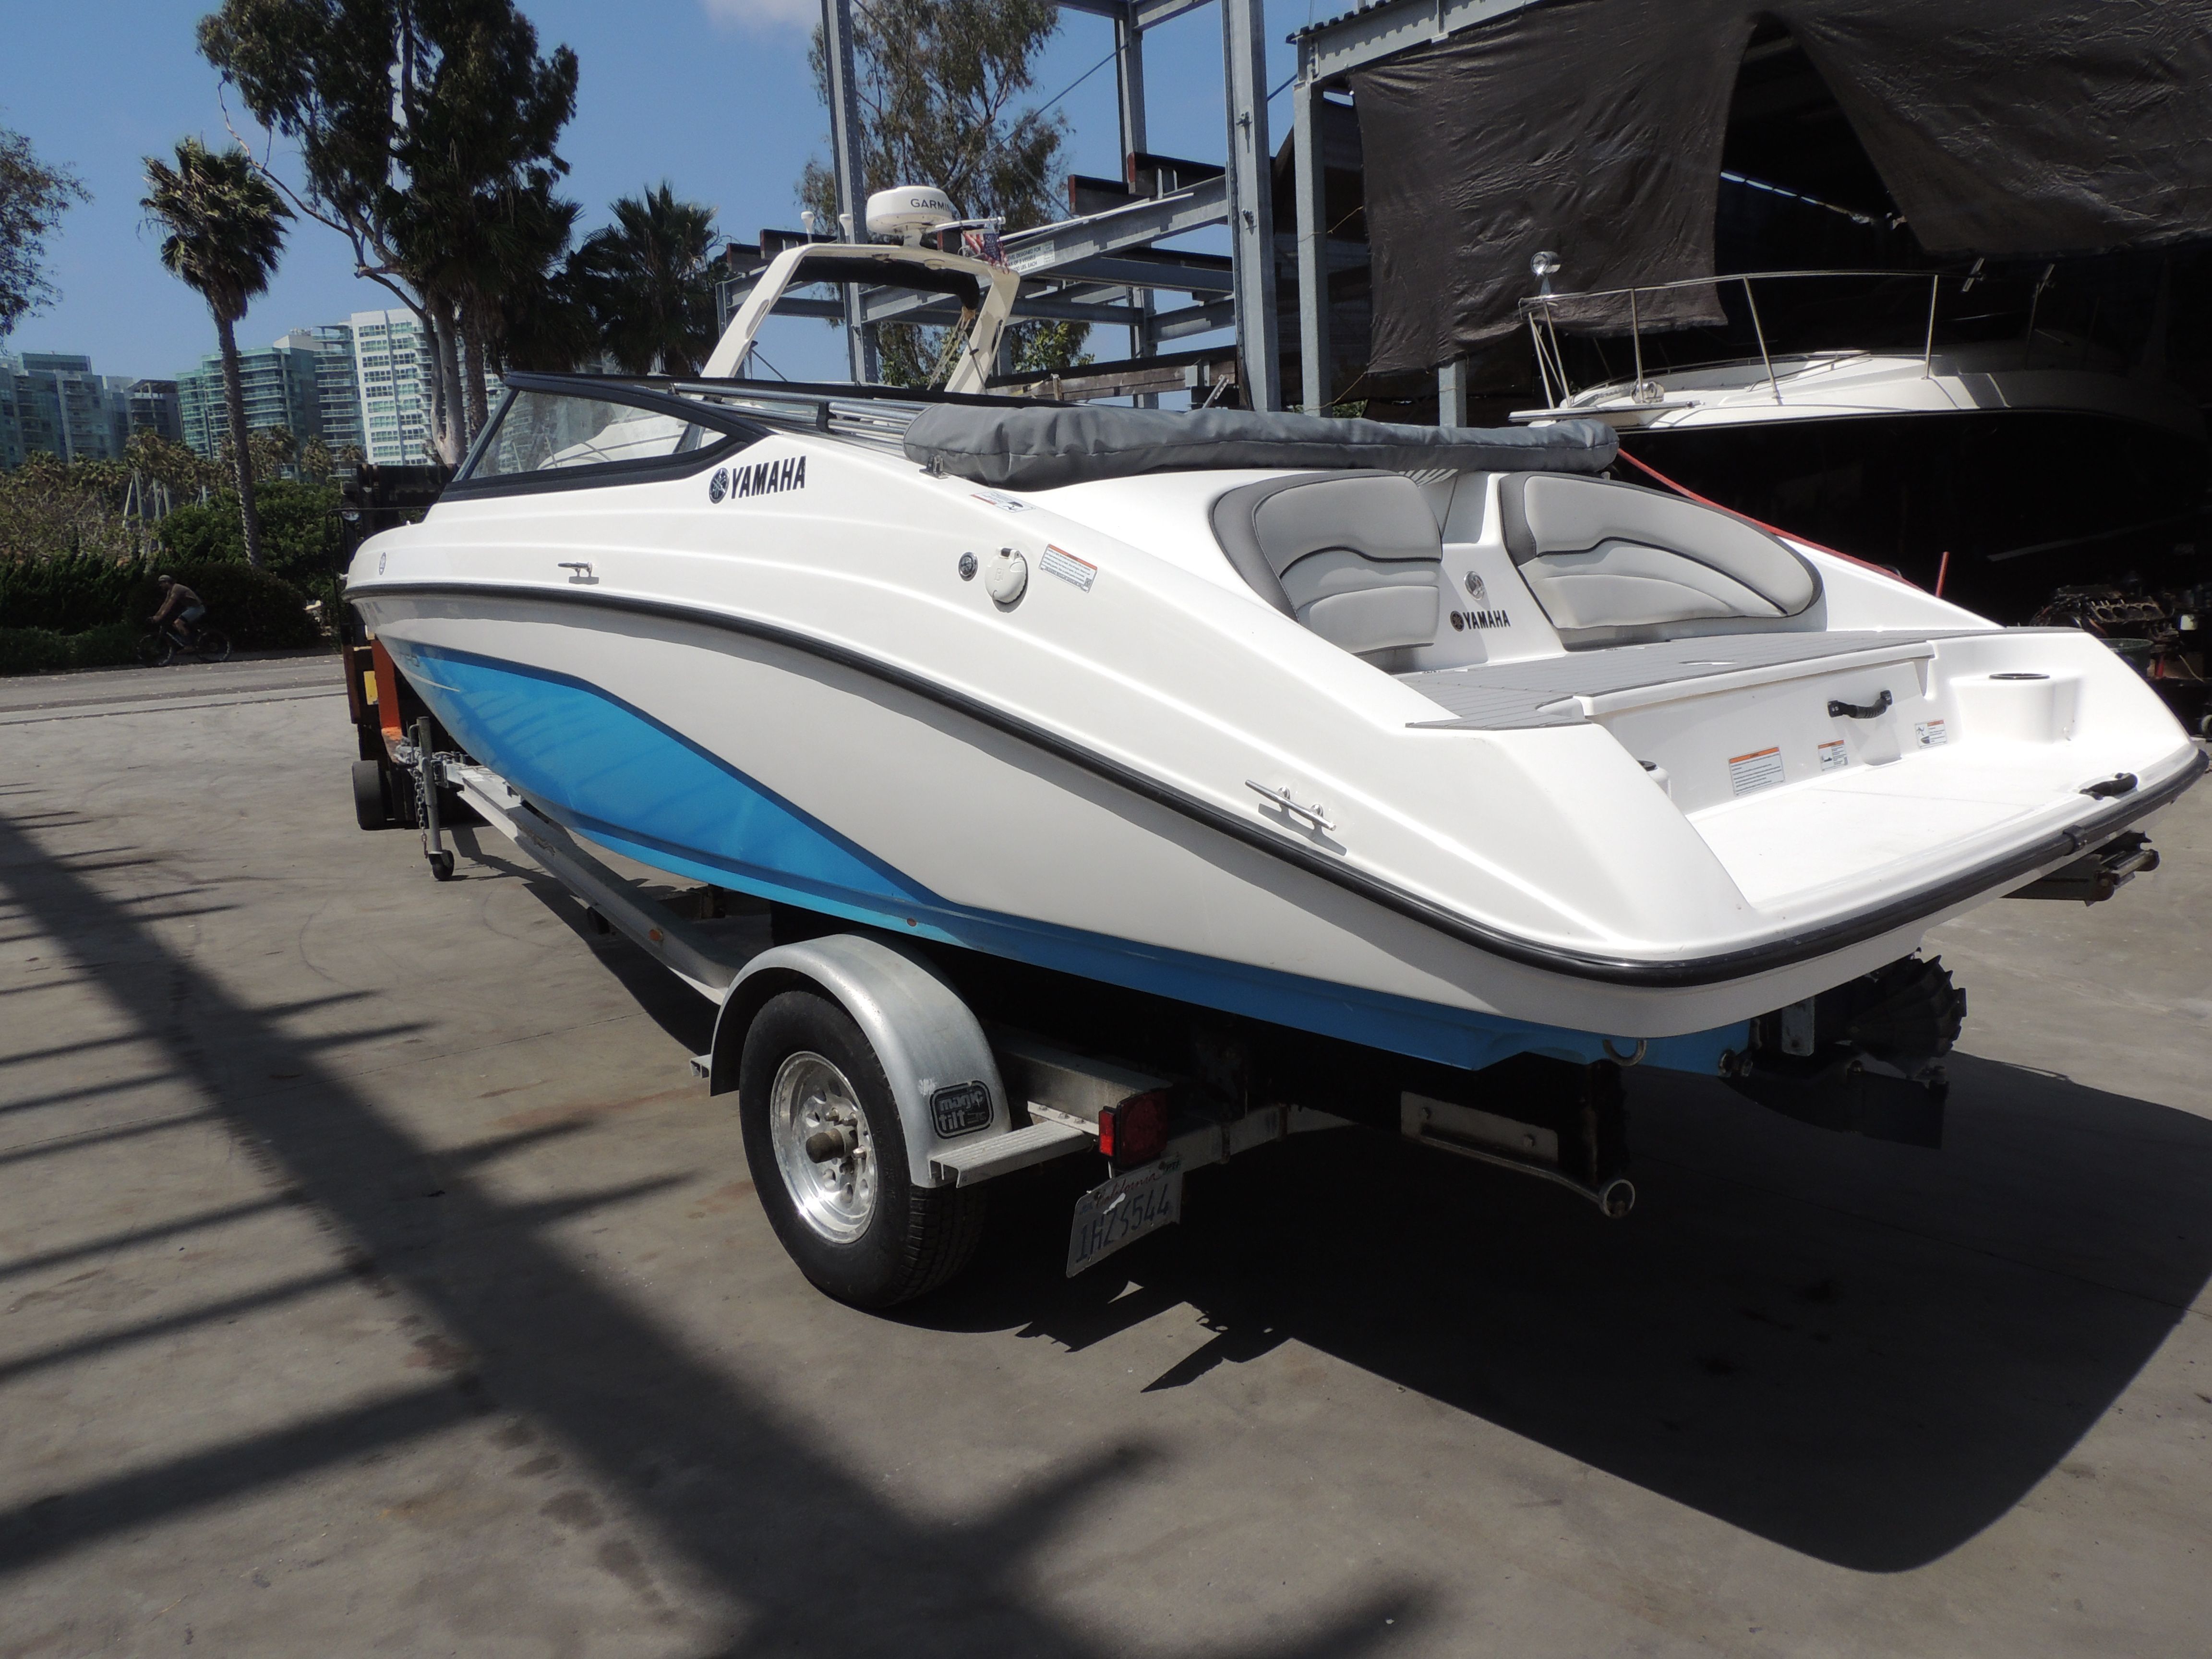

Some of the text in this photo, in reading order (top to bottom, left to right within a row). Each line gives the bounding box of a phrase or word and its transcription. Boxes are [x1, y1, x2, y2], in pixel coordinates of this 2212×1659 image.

[731, 456, 806, 499] YAMAHA
[1463, 610, 1511, 630] YAMAHA
[939, 1089, 984, 1110] magic
[939, 1109, 965, 1131] tilt
